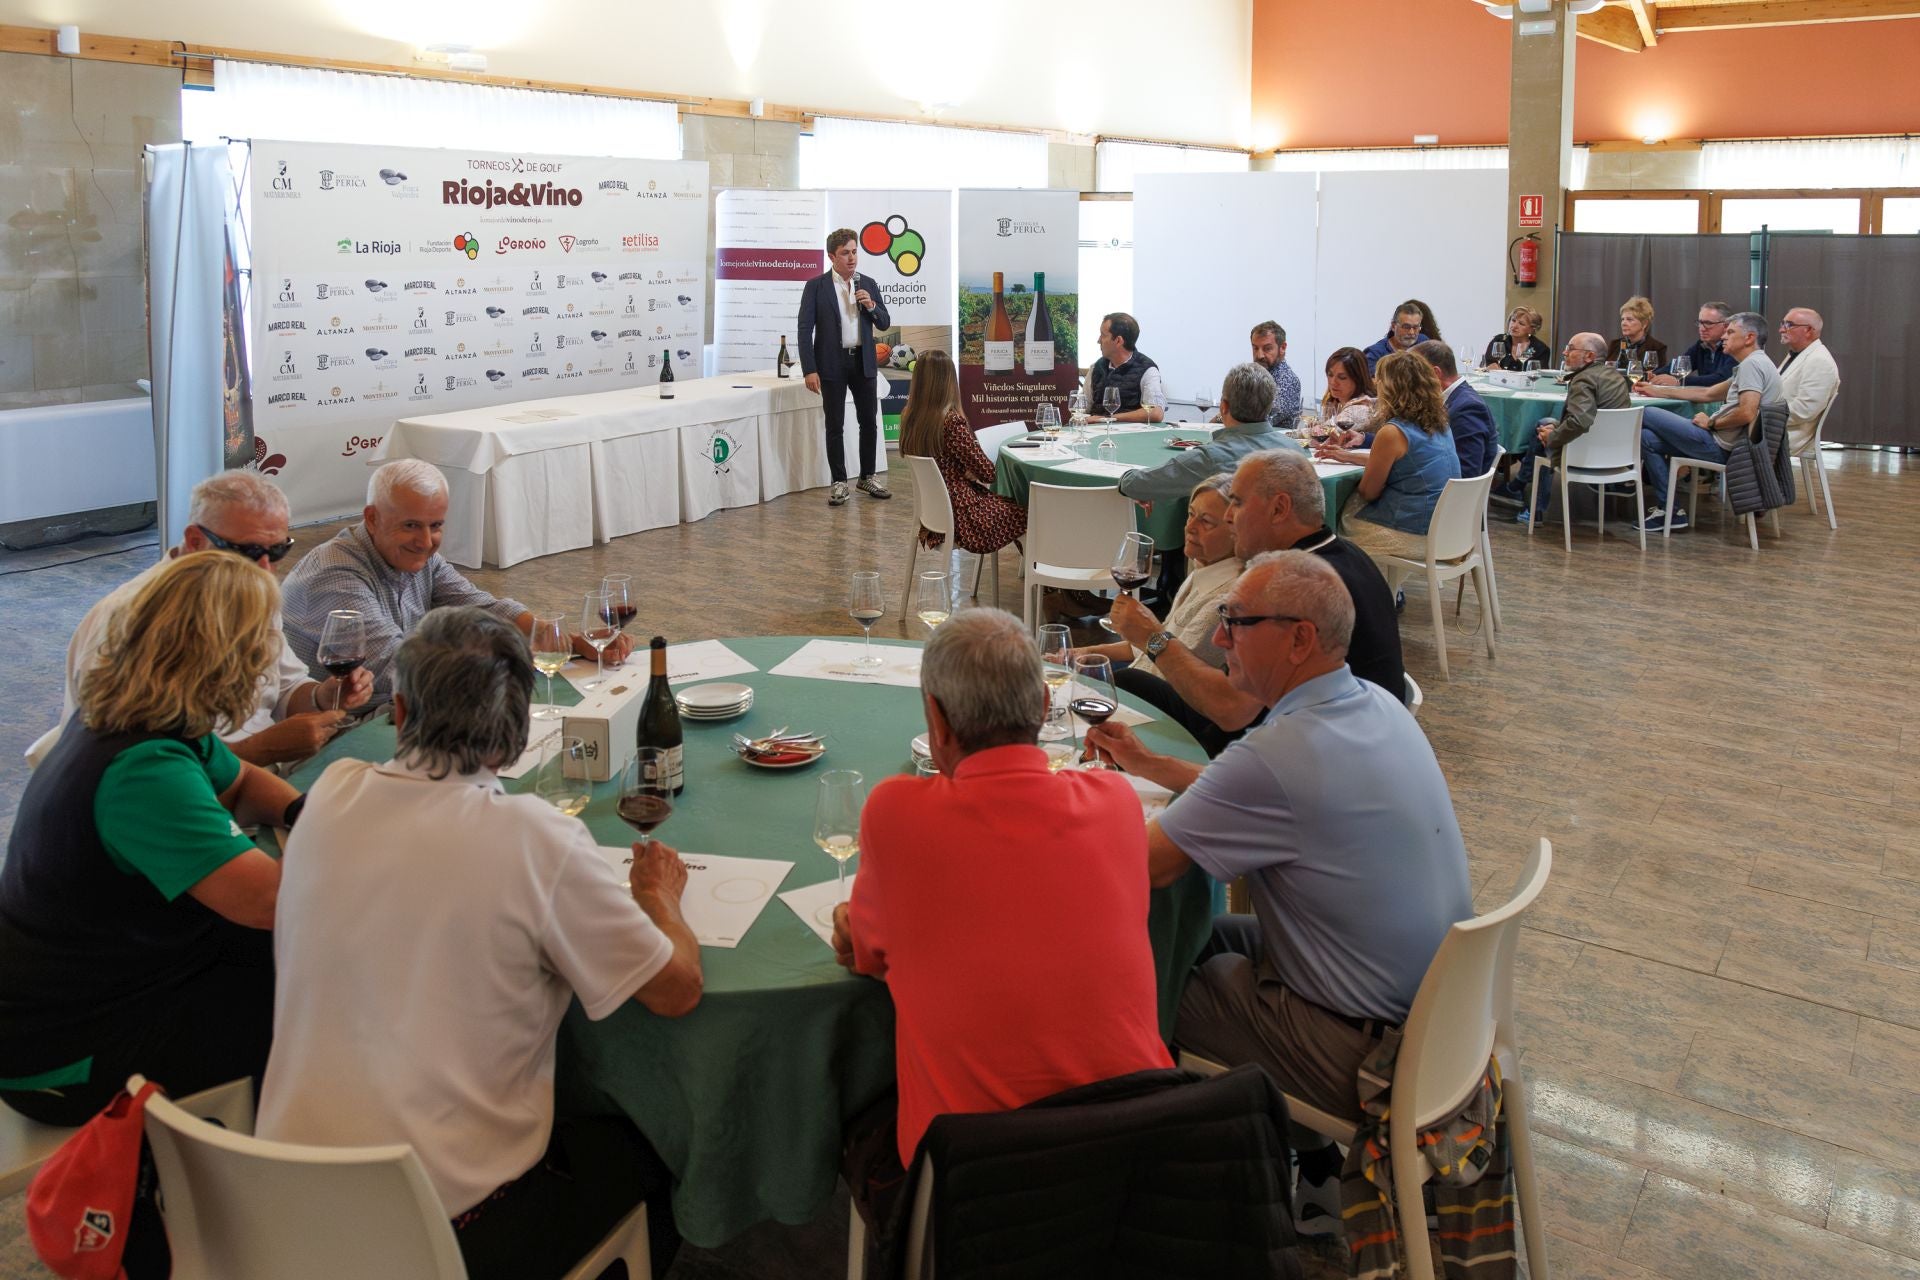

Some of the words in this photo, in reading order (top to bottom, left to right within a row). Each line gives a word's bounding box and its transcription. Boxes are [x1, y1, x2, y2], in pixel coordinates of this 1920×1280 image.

[467, 159, 511, 171] TORNEOS
[526, 162, 538, 172] DE
[539, 163, 563, 173] GOLF
[272, 177, 292, 190] CM
[335, 178, 367, 188] PERICA
[598, 180, 616, 191] MARCO
[616, 180, 630, 191] REAL
[442, 178, 583, 209] Rioja&Vino
[637, 191, 668, 199] ALTANZA
[1013, 225, 1046, 234] PERICA
[498, 236, 546, 250] LOGROÑO
[576, 237, 599, 247] Logroño
[626, 232, 660, 247] etilisa
[355, 241, 369, 254] La
[371, 241, 401, 255] Rioja
[719, 258, 818, 270] lomejordelvinoderioja.com
[618, 271, 632, 281] MARCO
[404, 280, 423, 291] MARCO
[423, 280, 437, 290] REAL
[530, 282, 542, 291] CM
[279, 291, 295, 302] CM
[329, 288, 355, 297] PERICA
[445, 287, 477, 296] ALTANZA
[883, 295, 927, 307] Deporte
[522, 306, 539, 316] MARCO
[539, 306, 551, 315] REAL
[556, 312, 584, 320] ALTANZA
[267, 320, 291, 332] MARCO
[291, 320, 307, 330] REAL
[414, 318, 428, 329] CM
[316, 327, 355, 336] ALTANZA
[617, 330, 632, 339] MARCO
[648, 334, 672, 342] ALTANZA
[404, 346, 423, 358] MARCO
[423, 346, 438, 356] REAL
[530, 342, 542, 353] CM
[445, 351, 478, 361] ALTANZA
[330, 358, 356, 367] PERICA
[279, 363, 296, 375] CM
[522, 367, 538, 378] MARCO
[538, 367, 550, 376] REAL
[556, 371, 583, 380] ALTANZA
[414, 385, 428, 395] CM
[983, 382, 1015, 391] Viñedos
[1016, 382, 1057, 393] Singulares
[268, 392, 291, 404] MARCO
[291, 392, 308, 401] REAL
[317, 396, 356, 406] ALTANZA
[362, 391, 399, 401] MONTECILLO
[971, 394, 985, 403] Mil
[985, 393, 1019, 402] historias
[1030, 393, 1049, 402] cada
[1049, 394, 1068, 404] copa
